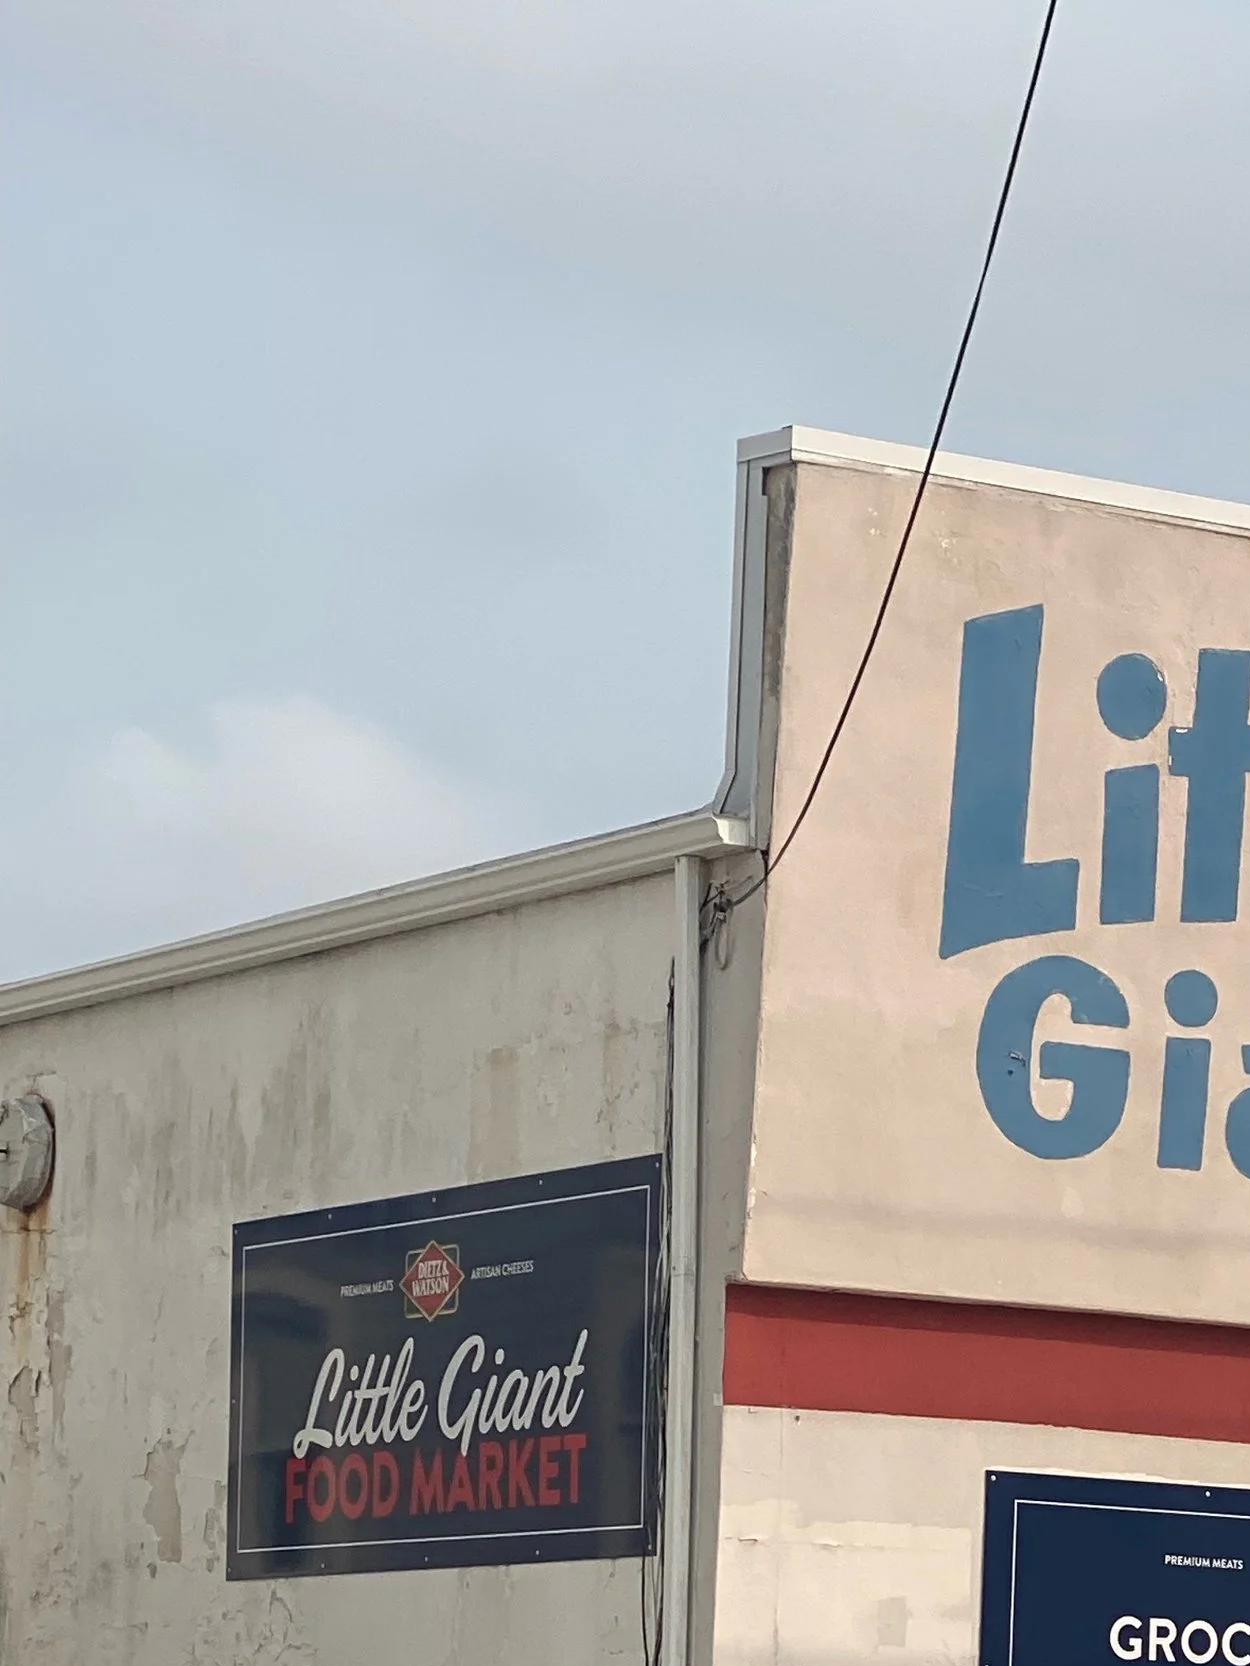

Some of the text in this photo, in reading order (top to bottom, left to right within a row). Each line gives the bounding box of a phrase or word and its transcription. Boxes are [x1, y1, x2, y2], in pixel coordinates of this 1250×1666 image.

[470, 1260, 534, 1280] ARTISAN CHEESES
[372, 1279, 394, 1294] MEATS
[412, 1276, 450, 1297] WATSON
[294, 1329, 588, 1459] Little Giant
[285, 1434, 588, 1524] FOOD MARKET
[1164, 1554, 1243, 1569] PREMIUM MEATS
